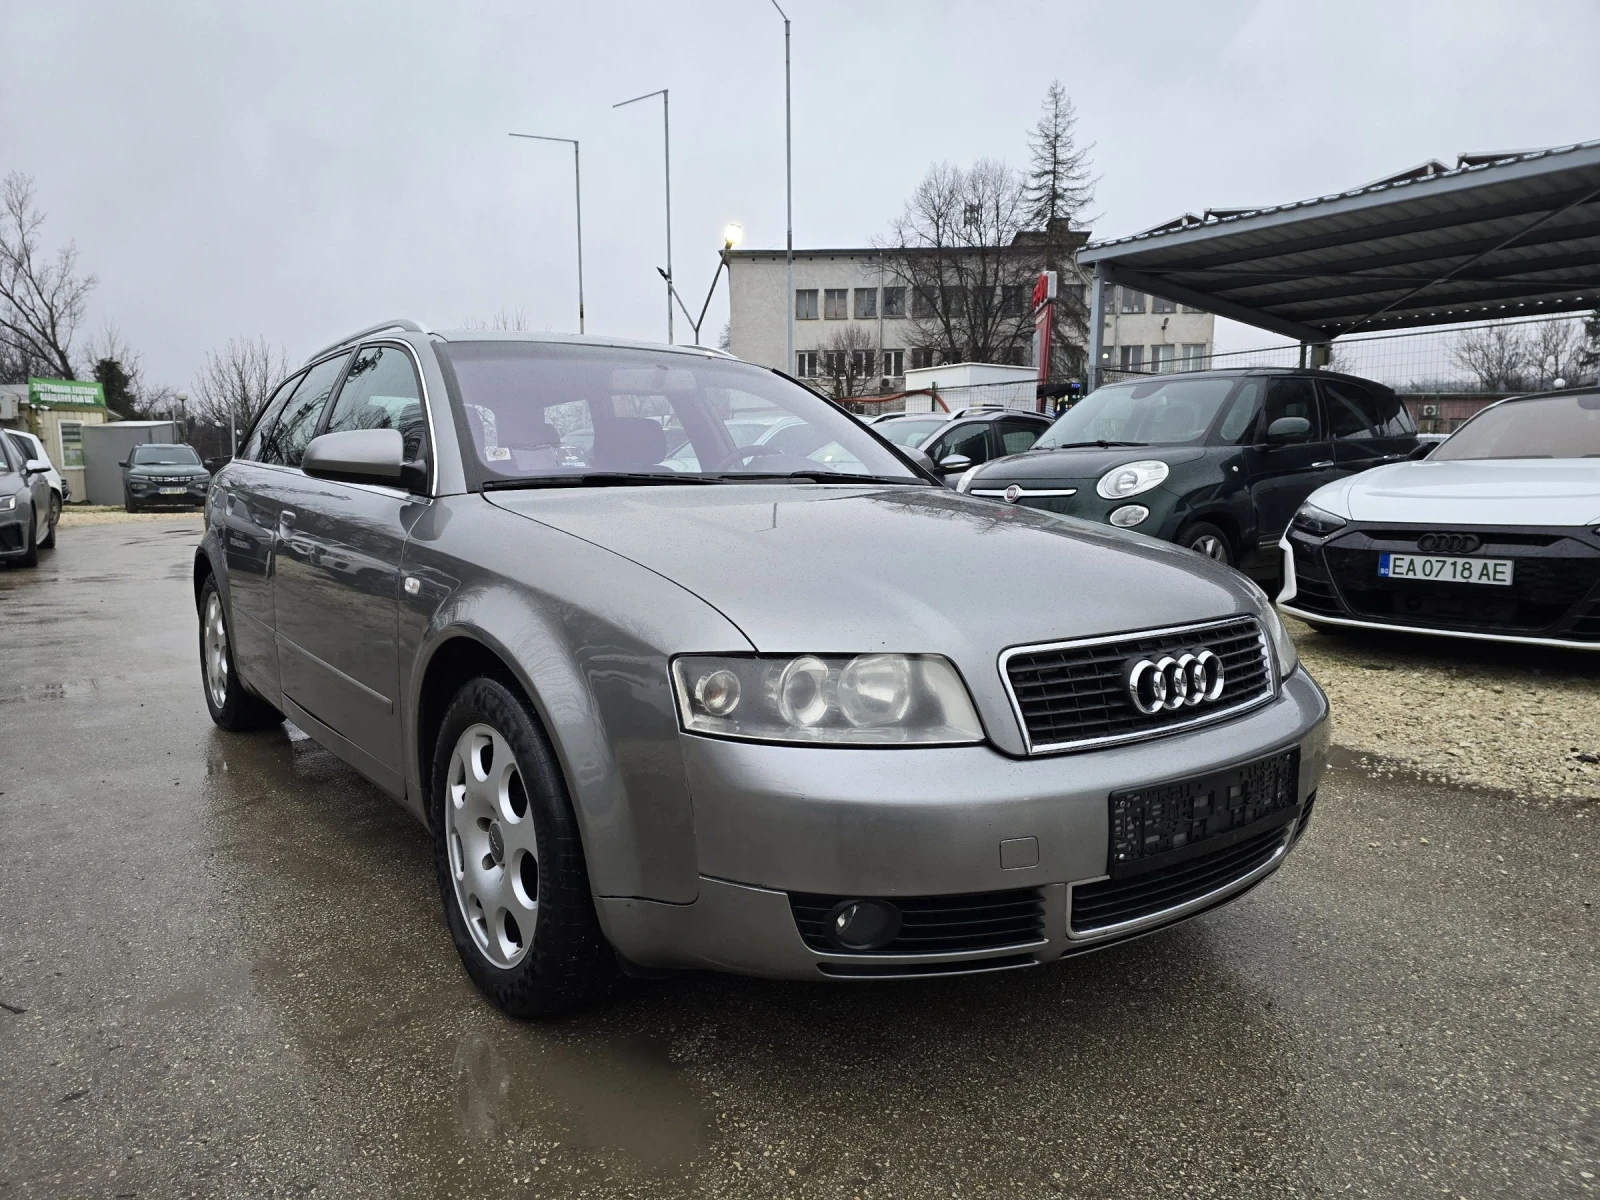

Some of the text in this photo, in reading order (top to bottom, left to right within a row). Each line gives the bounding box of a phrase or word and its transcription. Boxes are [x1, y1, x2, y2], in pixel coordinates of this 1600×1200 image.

[1392, 557, 1417, 576] EA
[1422, 559, 1472, 579] 0718
[1478, 562, 1507, 582] AE
